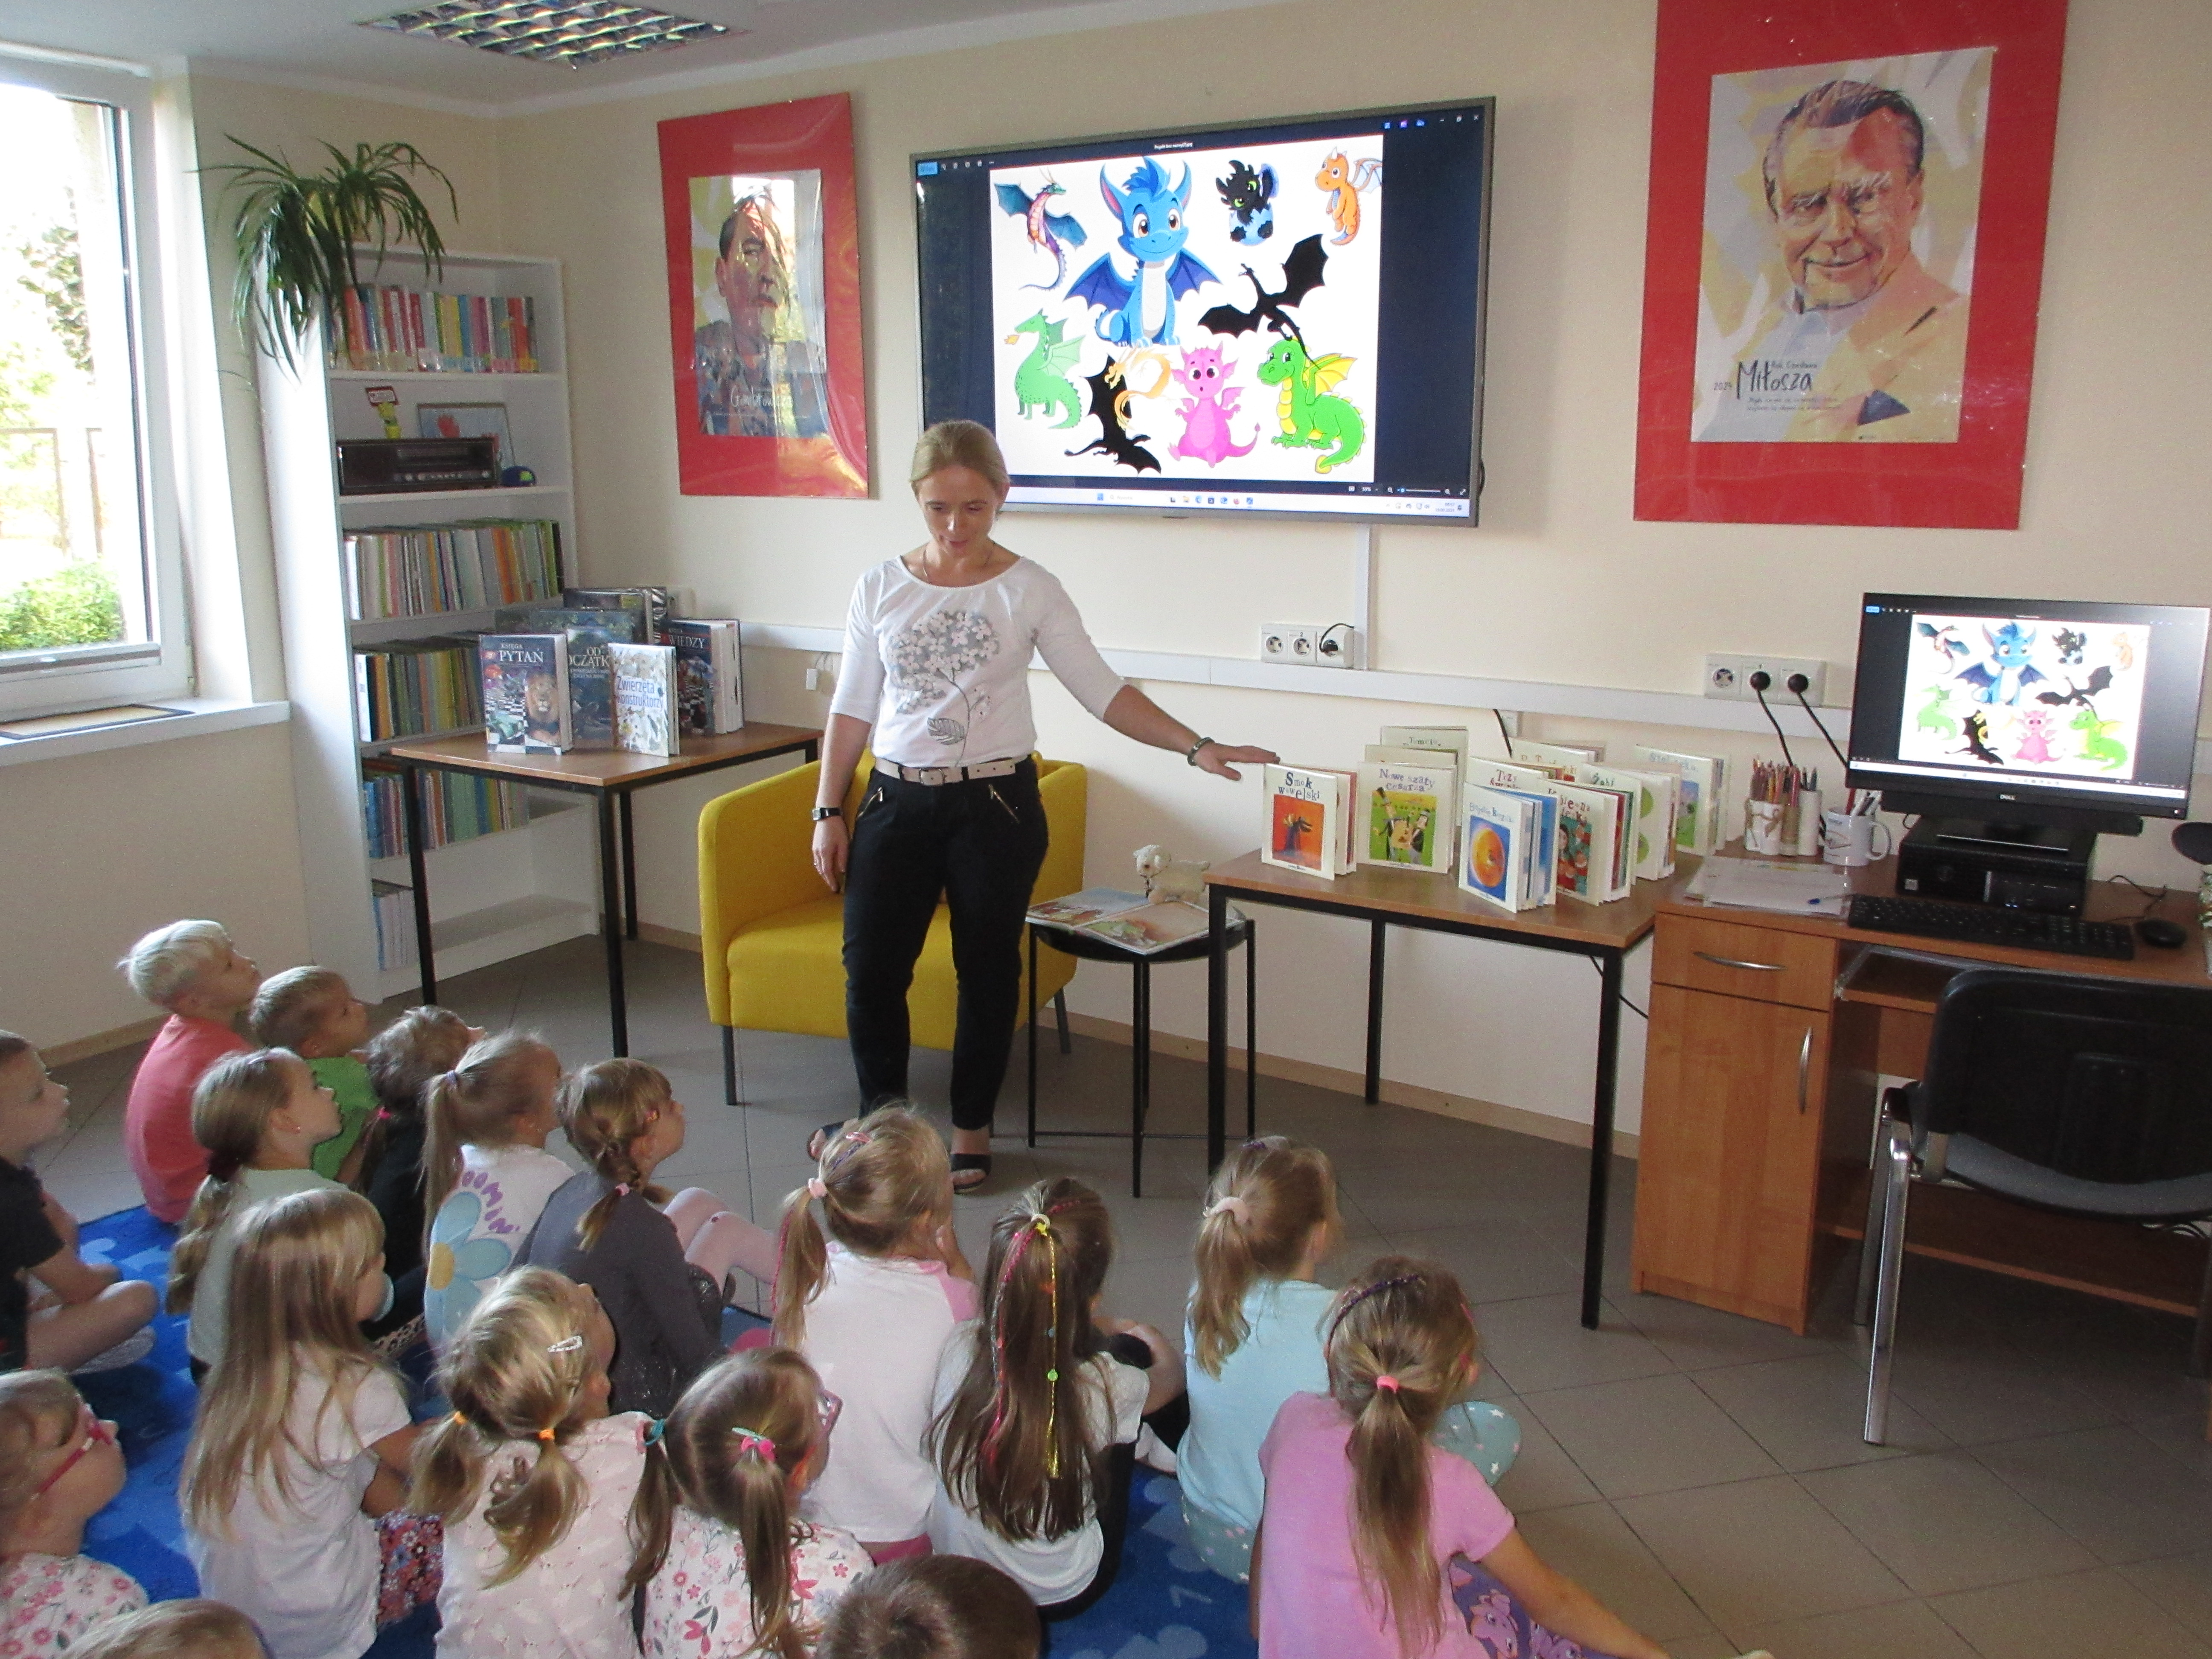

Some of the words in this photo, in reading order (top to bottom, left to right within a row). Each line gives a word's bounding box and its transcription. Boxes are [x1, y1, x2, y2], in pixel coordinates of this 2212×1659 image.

[499, 648, 543, 663] PYTAŃ
[617, 675, 655, 694] Zwierzęta
[1285, 771, 1312, 789] Smok
[1278, 786, 1320, 801] wawelski
